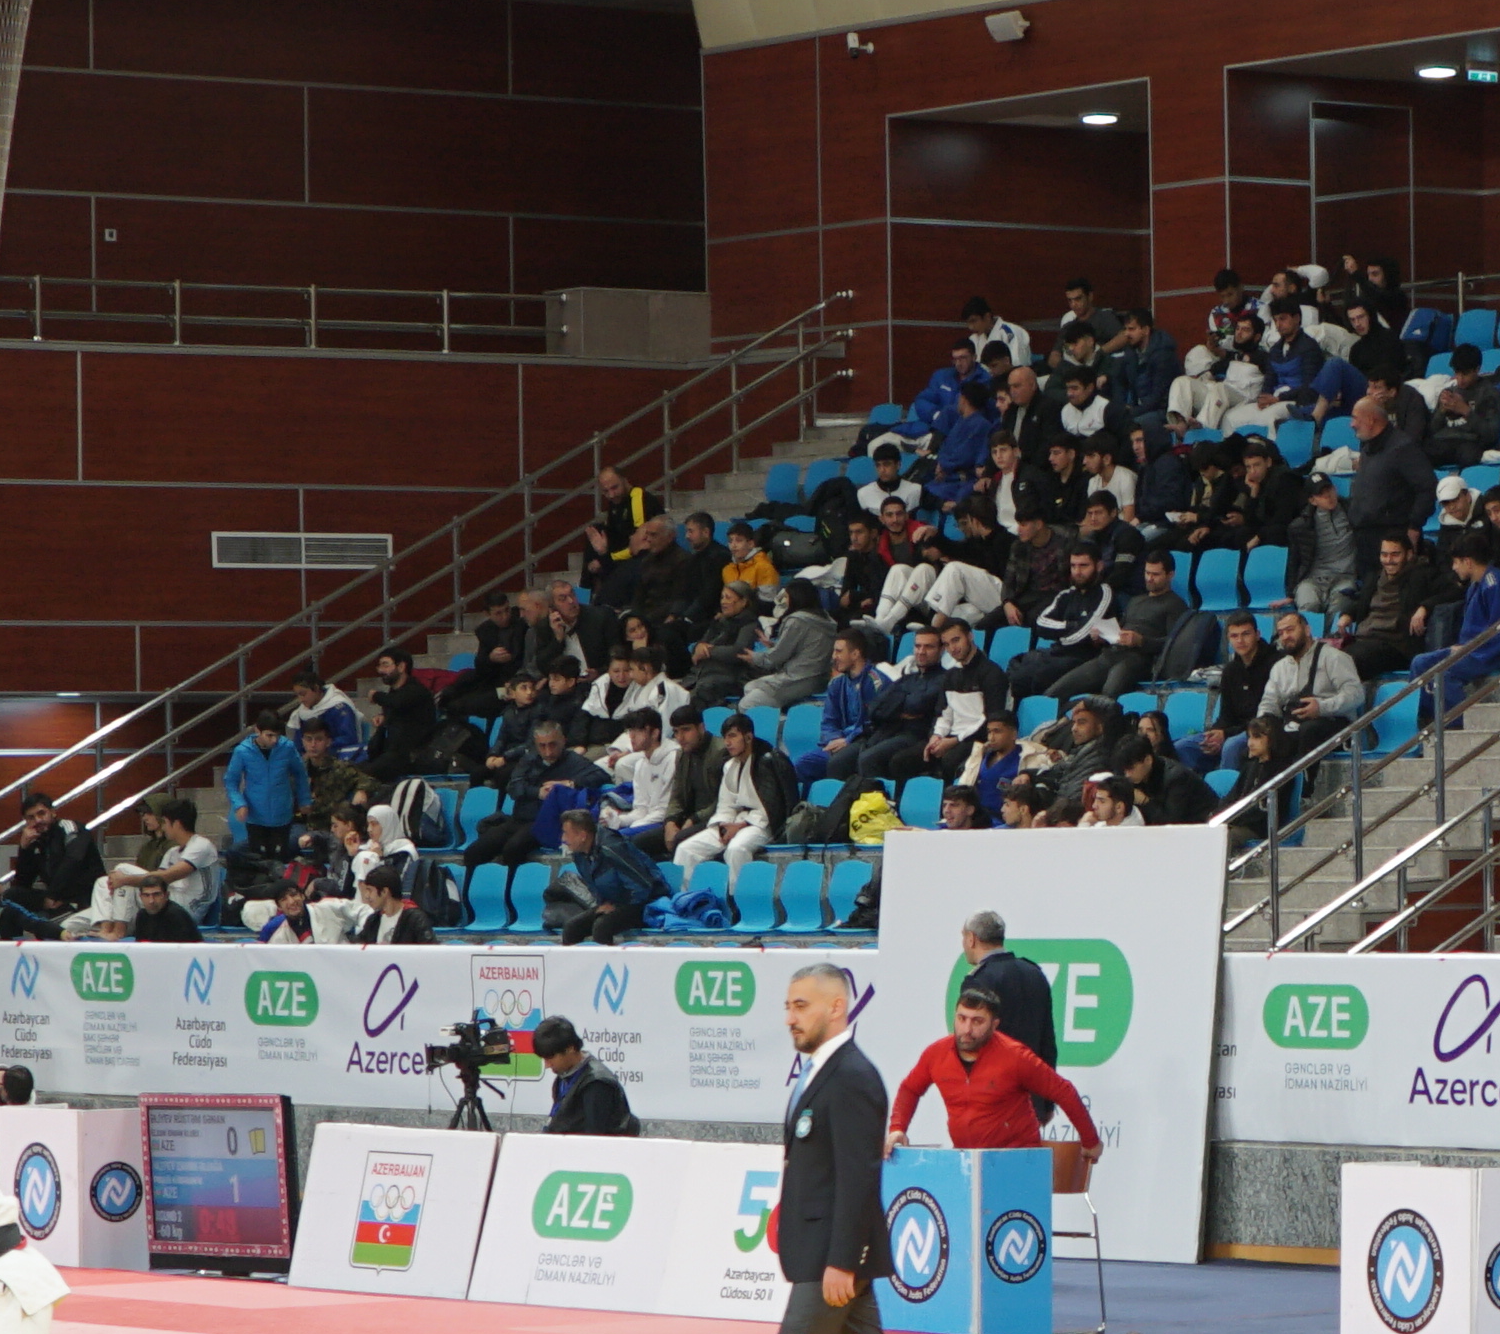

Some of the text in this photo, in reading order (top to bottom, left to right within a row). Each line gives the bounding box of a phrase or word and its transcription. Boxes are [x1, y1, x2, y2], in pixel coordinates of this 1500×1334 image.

[81, 960, 124, 994] AZE
[478, 965, 540, 980] AZERBAIJAN
[688, 970, 743, 1007] AZE
[256, 980, 307, 1017] AZE
[175, 1016, 227, 1034] Azərbaycan
[1282, 994, 1351, 1039] AZE
[14, 1028, 37, 1043] Cüdo
[188, 1034, 212, 1049] Cüdo
[0, 1044, 53, 1062] Federasiyası
[172, 1051, 228, 1070] Federasiyası
[597, 1046, 626, 1063] Cüdo
[226, 1126, 239, 1156] 0
[371, 1161, 426, 1178] AZERBAIJAN
[546, 1182, 618, 1231] AZE
